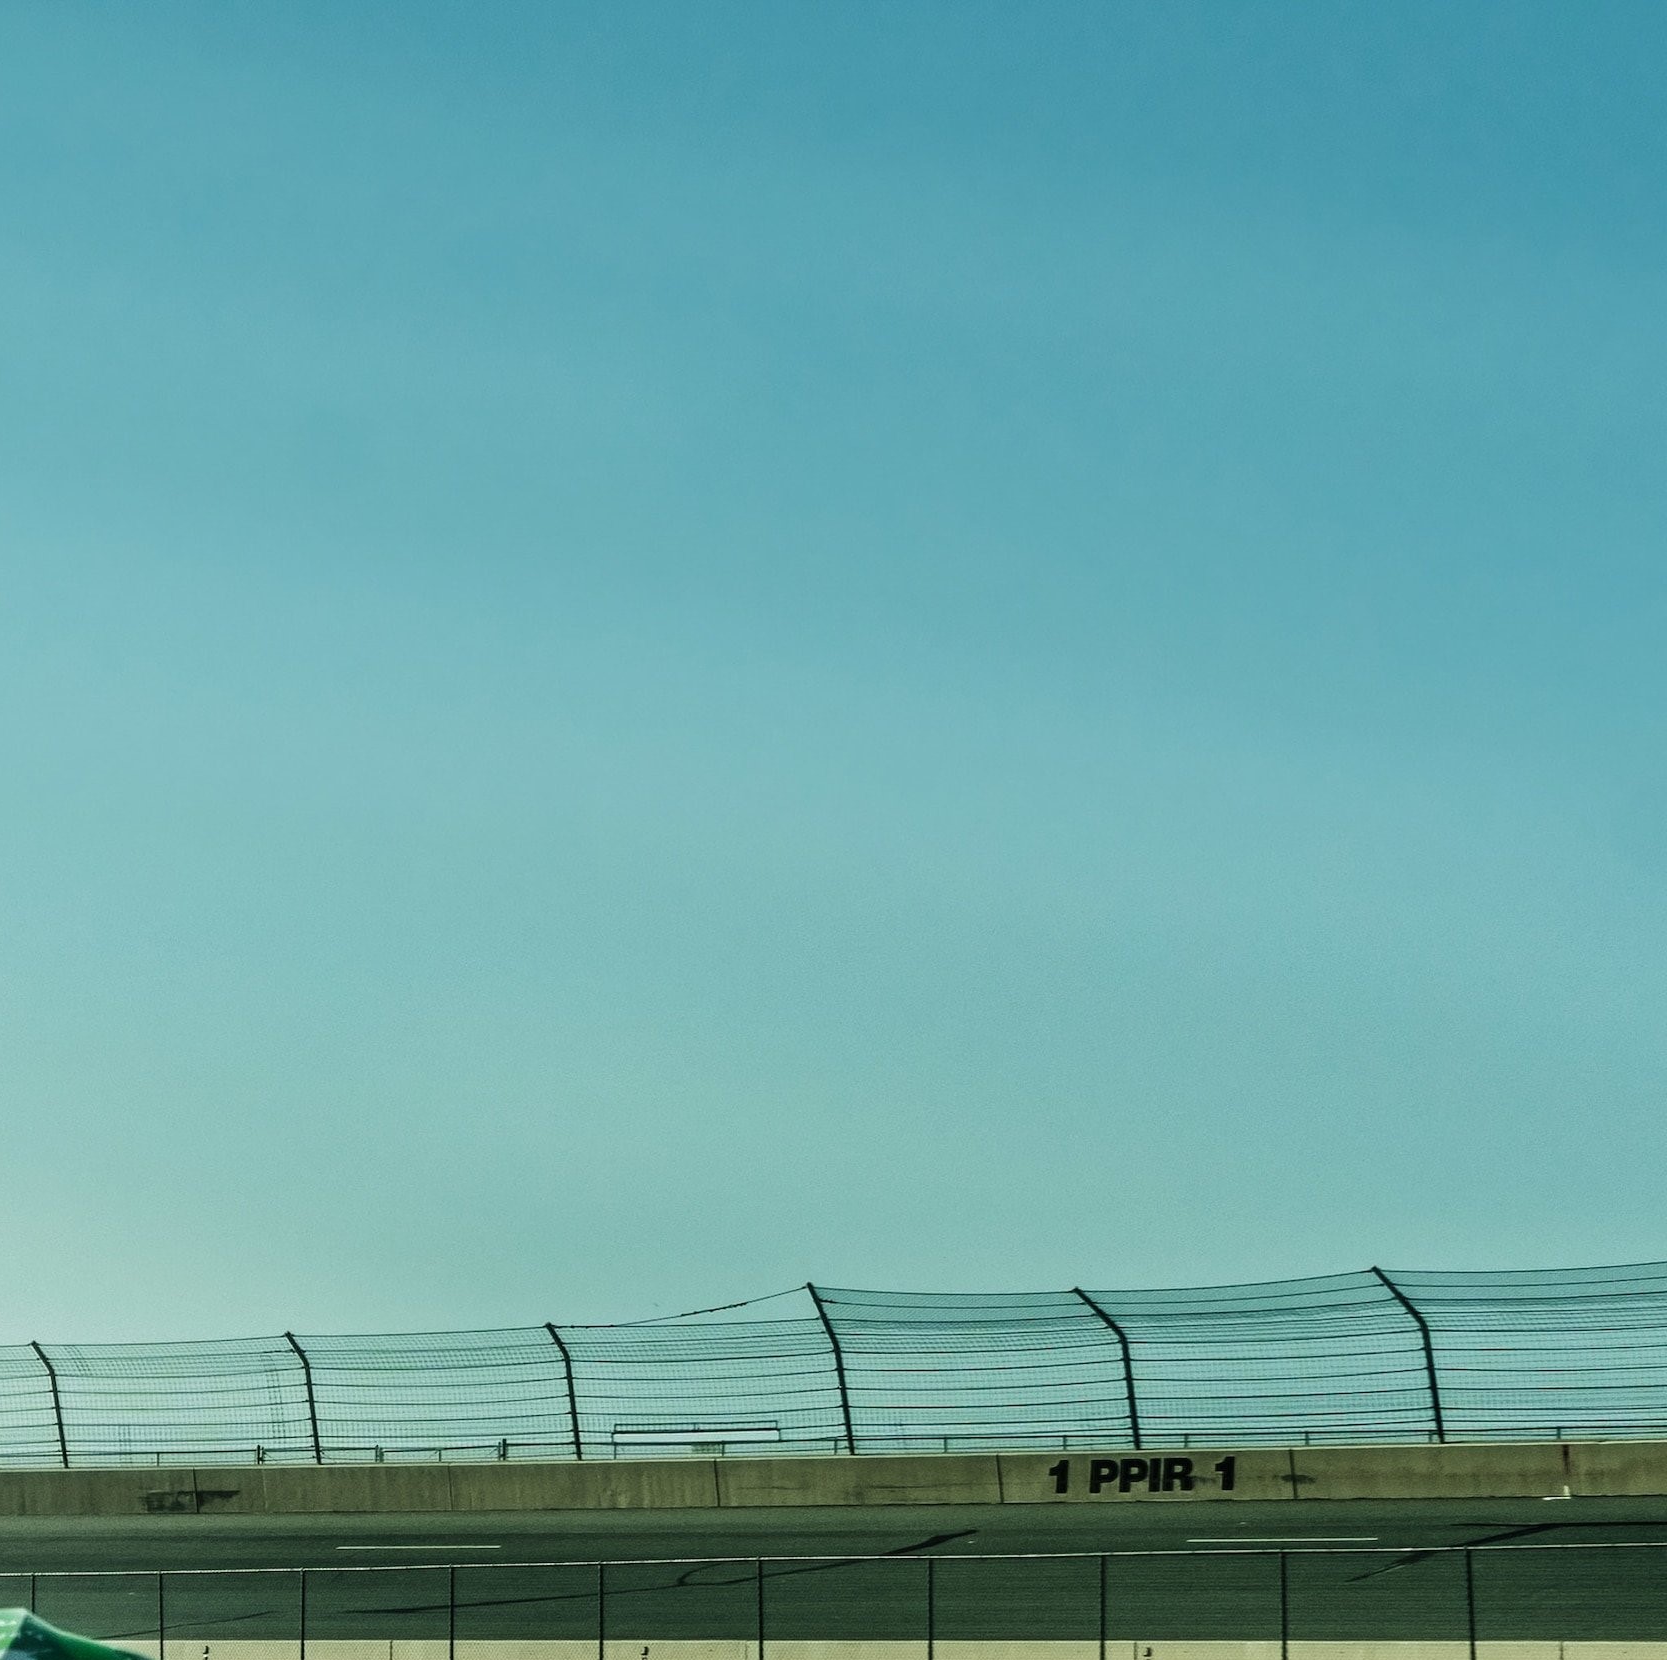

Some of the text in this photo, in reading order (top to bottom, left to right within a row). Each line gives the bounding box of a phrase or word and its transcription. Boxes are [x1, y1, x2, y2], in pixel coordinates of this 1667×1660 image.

[1049, 1456, 1235, 1494] 1 PPIR 1
